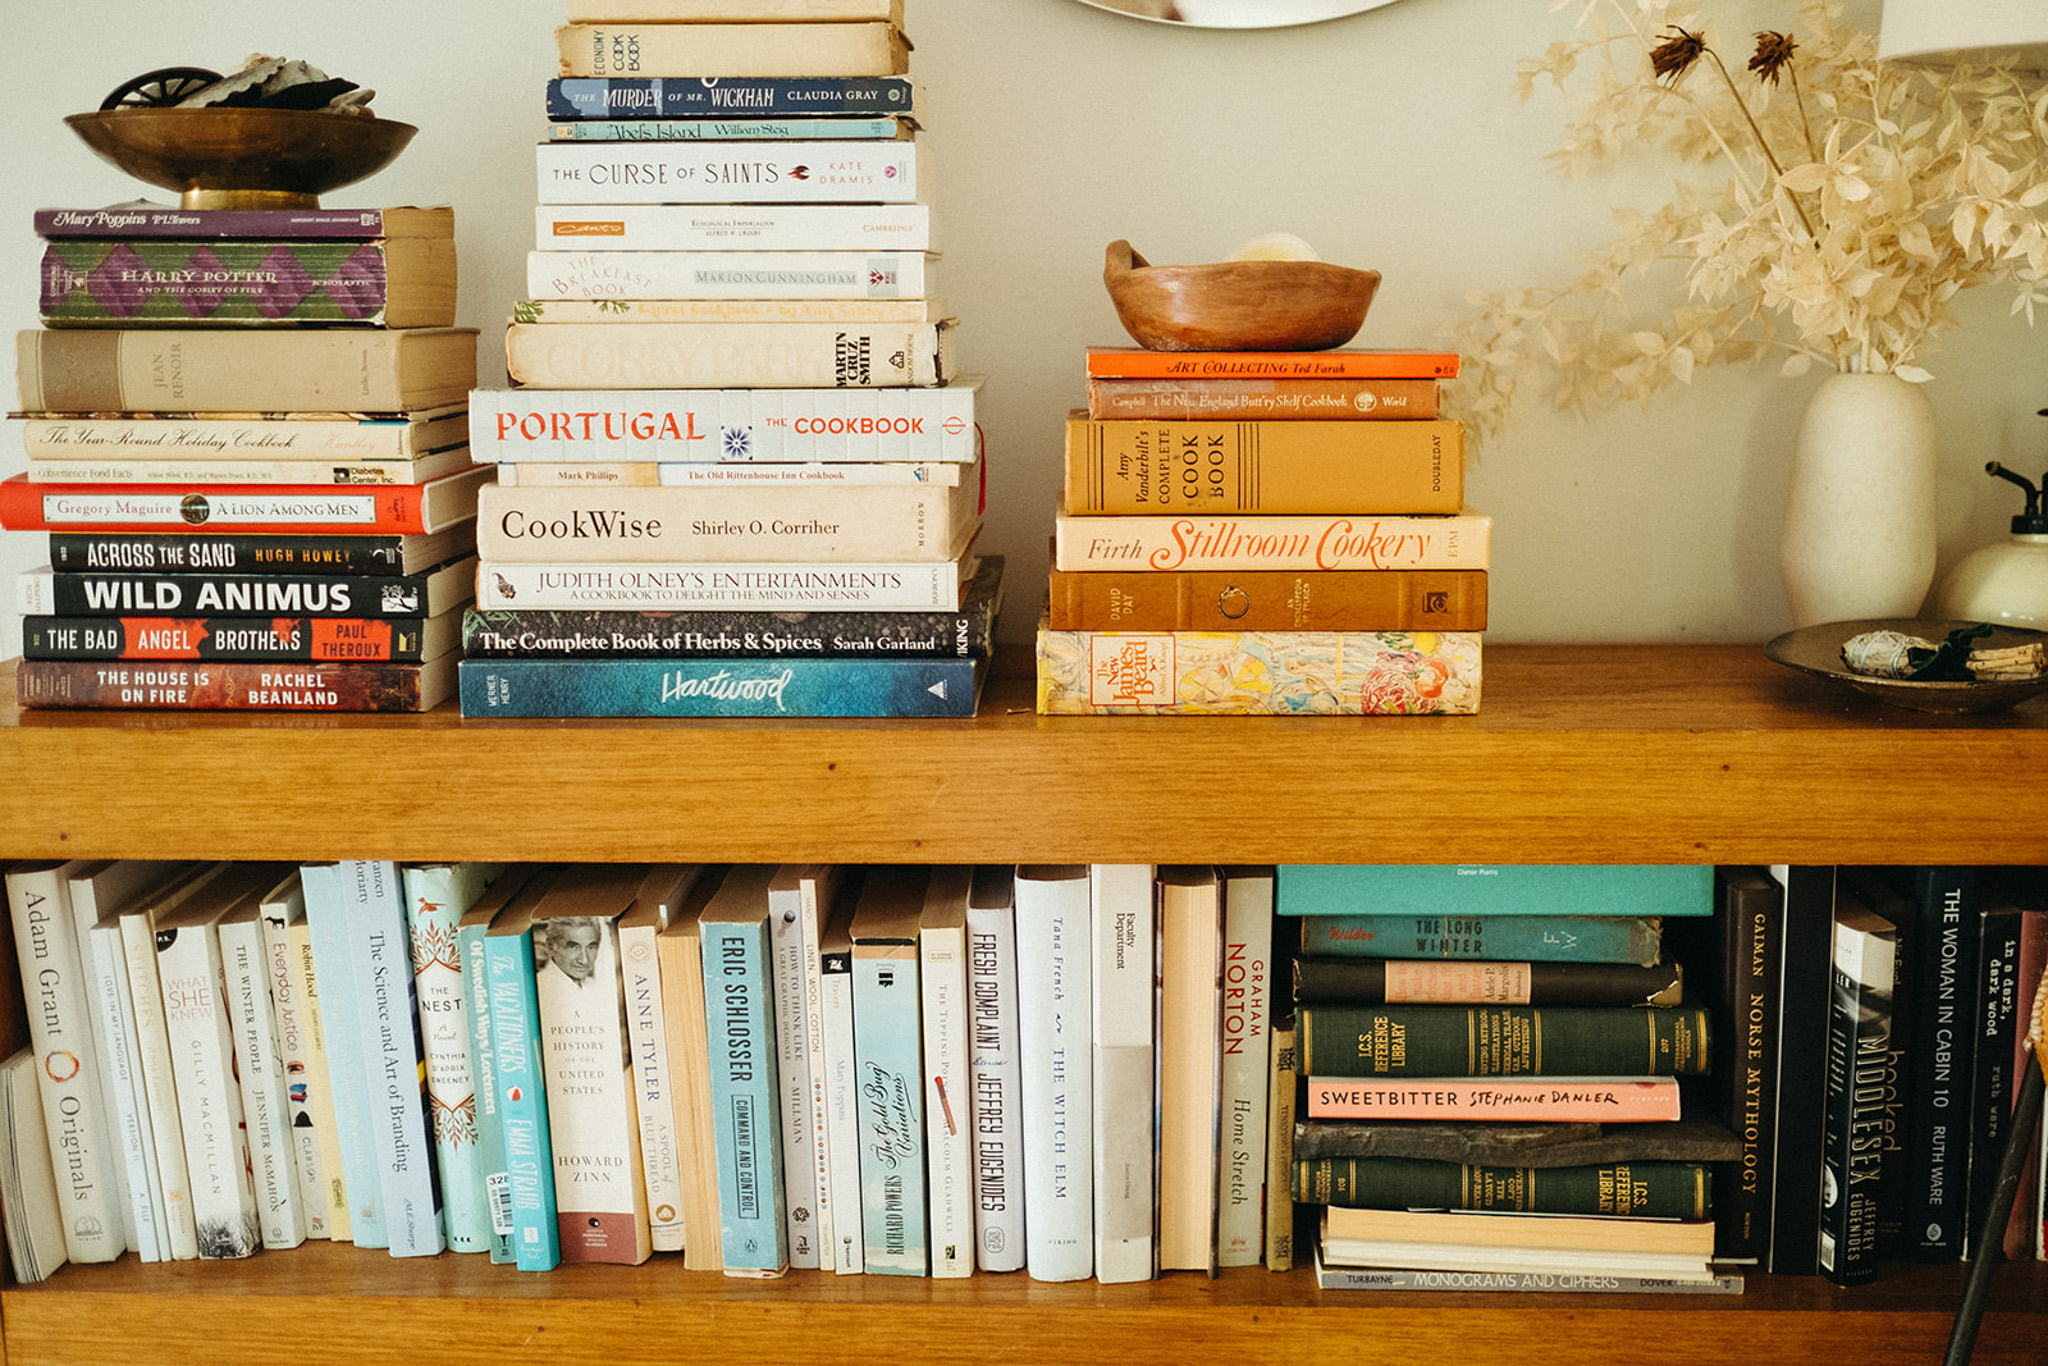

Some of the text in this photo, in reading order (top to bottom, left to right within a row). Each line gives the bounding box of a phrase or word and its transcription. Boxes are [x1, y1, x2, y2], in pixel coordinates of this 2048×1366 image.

[593, 29, 606, 77] ECONOMY
[612, 33, 625, 72] COOK
[574, 87, 775, 110] THE MURDER OF MR. WICKHAM
[786, 90, 879, 101] CLAUDIA GRAY
[553, 162, 780, 185] THE CURSE OF SAINTS
[820, 175, 874, 185] DRAMIS
[829, 162, 863, 171] KATE
[122, 271, 278, 284] HARRY POTTER
[172, 343, 184, 400] RENOIR
[847, 340, 859, 381] CRUZ
[859, 336, 871, 385] SMITH
[1292, 362, 1346, 375] Ted Farah
[496, 411, 924, 441] PORTUGAL THE COOKBOOK
[558, 471, 620, 482] Mark Phillips
[1117, 452, 1134, 480] Amy
[1158, 429, 1171, 504] COMPLETE
[1182, 435, 1199, 499] COOK
[1207, 433, 1225, 499] BOOK
[1432, 433, 1442, 492] DOUBLEDAY
[216, 502, 360, 516] A LION AMONG MEN
[502, 510, 663, 539] CookWise
[88, 542, 237, 567] ACROSS THE SAND
[1087, 539, 1143, 559] Firth
[83, 581, 352, 612] WILD ANIMUS
[570, 590, 870, 600] A COOKBOOK TO DELIGHT THE MIND AND SENSES
[1110, 588, 1121, 620] DAVID
[1123, 594, 1134, 615] DAY
[480, 632, 822, 655] The Complete Book of Herbs & Spices
[832, 636, 936, 651] Sarah Garland
[97, 671, 210, 687] THE HOUSE IS
[262, 673, 326, 688] RACHEL
[501, 678, 511, 705] HENRY
[121, 689, 187, 704] ON FIRE
[249, 690, 339, 706] BEANLAND
[1457, 868, 1499, 877] Dieter Rams
[1115, 913, 1125, 970] Department
[1126, 912, 1136, 948] Faculty
[25, 891, 62, 1036] Adam Grant
[301, 944, 313, 972] Robin
[1052, 917, 1065, 1001] Tana French
[304, 973, 318, 998] Hood
[430, 987, 449, 996] THE
[972, 933, 1001, 1052] FRESH COMPLAINT
[1999, 940, 2017, 1021] in a dark,
[236, 944, 262, 1075] THE WINTER PEOPLE
[422, 999, 462, 1012] NEST
[722, 937, 753, 1082] ERIC SCHLOSSER
[789, 945, 803, 1062] HOW TO THINK LIKE
[806, 944, 820, 1053] LINEN, WOOL, COTTON
[1225, 943, 1247, 1055] NORTON
[1250, 960, 1264, 1037] GRAHAM
[1933, 888, 1961, 1109] THE WOMAN IN CABIN 10
[1986, 959, 2003, 1037] dark wood
[169, 1007, 213, 1021] KNEW
[573, 1010, 580, 1018] A
[551, 1025, 605, 1036] PEOPLE'S
[1521, 1018, 1530, 1070] ADVERTISING
[369, 930, 408, 1174] The Science and Art of Branding
[429, 1052, 466, 1060] CYNTHIA
[553, 1041, 604, 1051] HISTORY
[1742, 913, 1767, 1194] GAIMAN NORSE MYTHOLOGY
[431, 1076, 470, 1084] SWEENEY
[558, 1070, 605, 1080] UNITED
[562, 1085, 603, 1095] STATES
[1320, 1091, 1459, 1106] SWEETBITTER
[1988, 1066, 2001, 1140] ruth ware
[791, 1086, 803, 1145] MILLMAN
[1053, 1048, 1066, 1199] THE WITCH ELM
[1849, 1034, 1890, 1185] MIDDLESEX
[59, 1096, 93, 1201] Originals
[735, 1099, 753, 1213] COMMAND AND CONTROL
[977, 1073, 1006, 1212] JEFFREY EUGENIDES
[1231, 1099, 1251, 1206] Home Stretch
[558, 1156, 623, 1167] HOWARD
[1928, 1126, 1947, 1206] RUTH WARE
[573, 1172, 612, 1182] ZINN
[1346, 1275, 1394, 1285] TURBAYNE
[1413, 1272, 1620, 1289] MONOGRAMS AND CIPHERS
